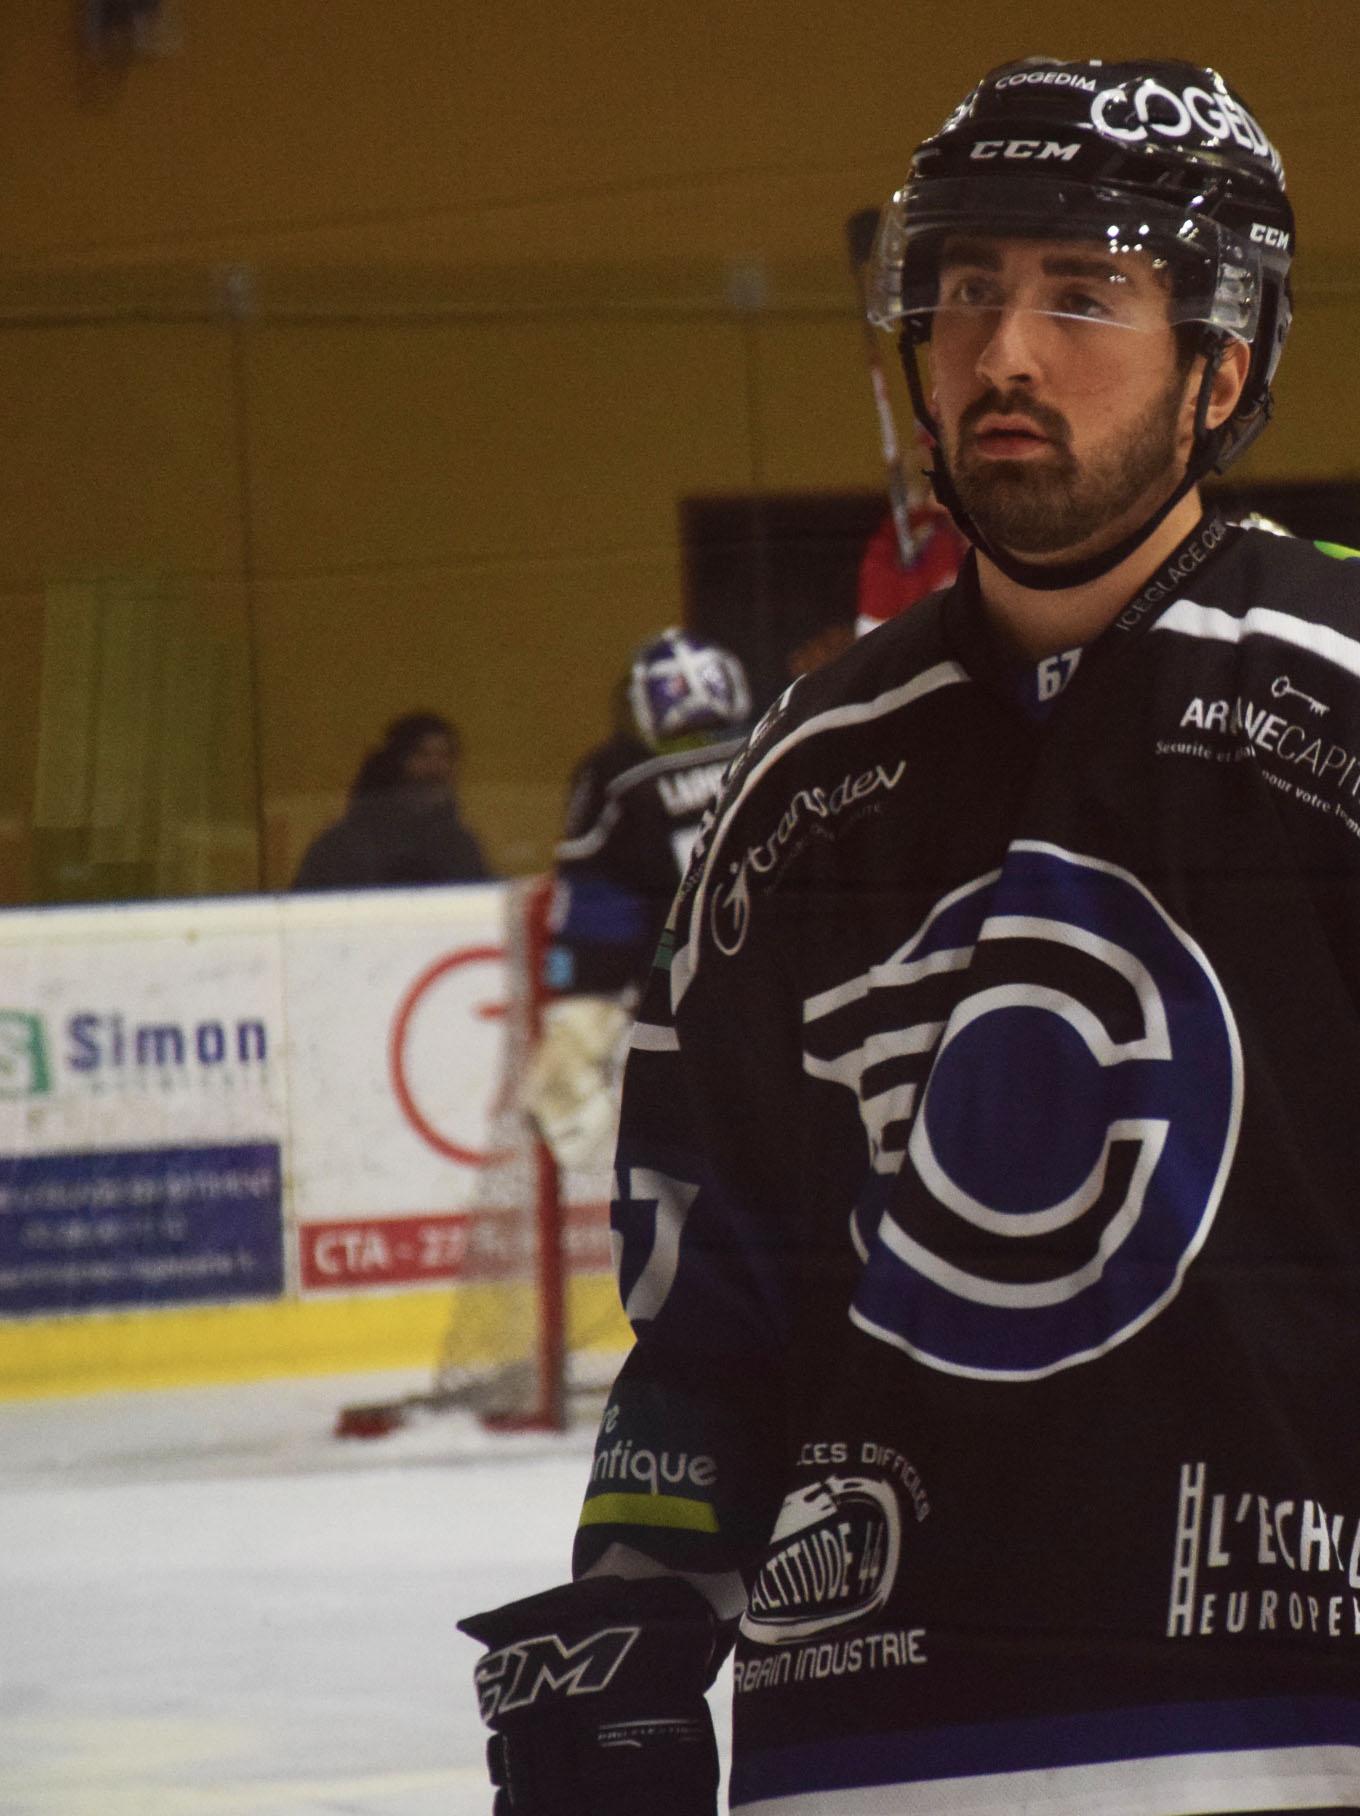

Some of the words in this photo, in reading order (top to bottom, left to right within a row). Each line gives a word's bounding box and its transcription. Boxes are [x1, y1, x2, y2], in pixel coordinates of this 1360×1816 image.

[995, 71, 1097, 92] COGEDIM
[969, 140, 1083, 161] CCM
[1090, 84, 1286, 192] COGED
[1250, 223, 1290, 250] CCM
[1037, 647, 1083, 702] 67
[67, 1011, 268, 1073] Simon
[313, 1227, 391, 1275] CTA
[609, 1166, 701, 1322] 7
[593, 1440, 718, 1497] ntique
[473, 1625, 642, 1732] CM
[733, 1651, 791, 1694] RBAIN
[794, 1628, 928, 1681] INDUSTRIE
